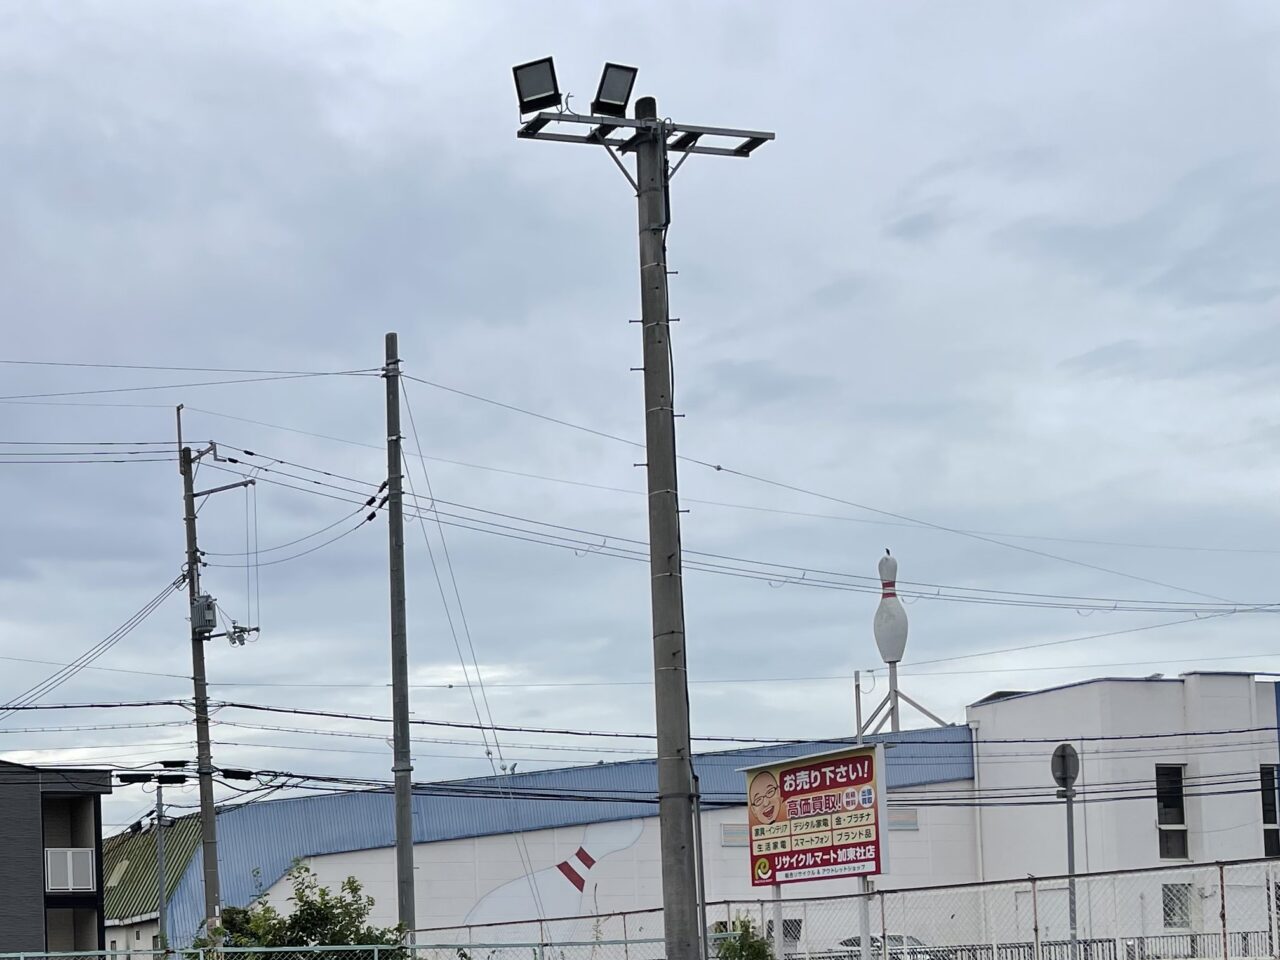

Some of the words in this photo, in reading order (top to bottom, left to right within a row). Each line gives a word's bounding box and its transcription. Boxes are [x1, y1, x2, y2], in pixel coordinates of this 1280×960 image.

[783, 761, 869, 791] お売り下さい!
[787, 793, 842, 817] 高価買取!
[774, 845, 876, 869] リサイクルマート加東社店
